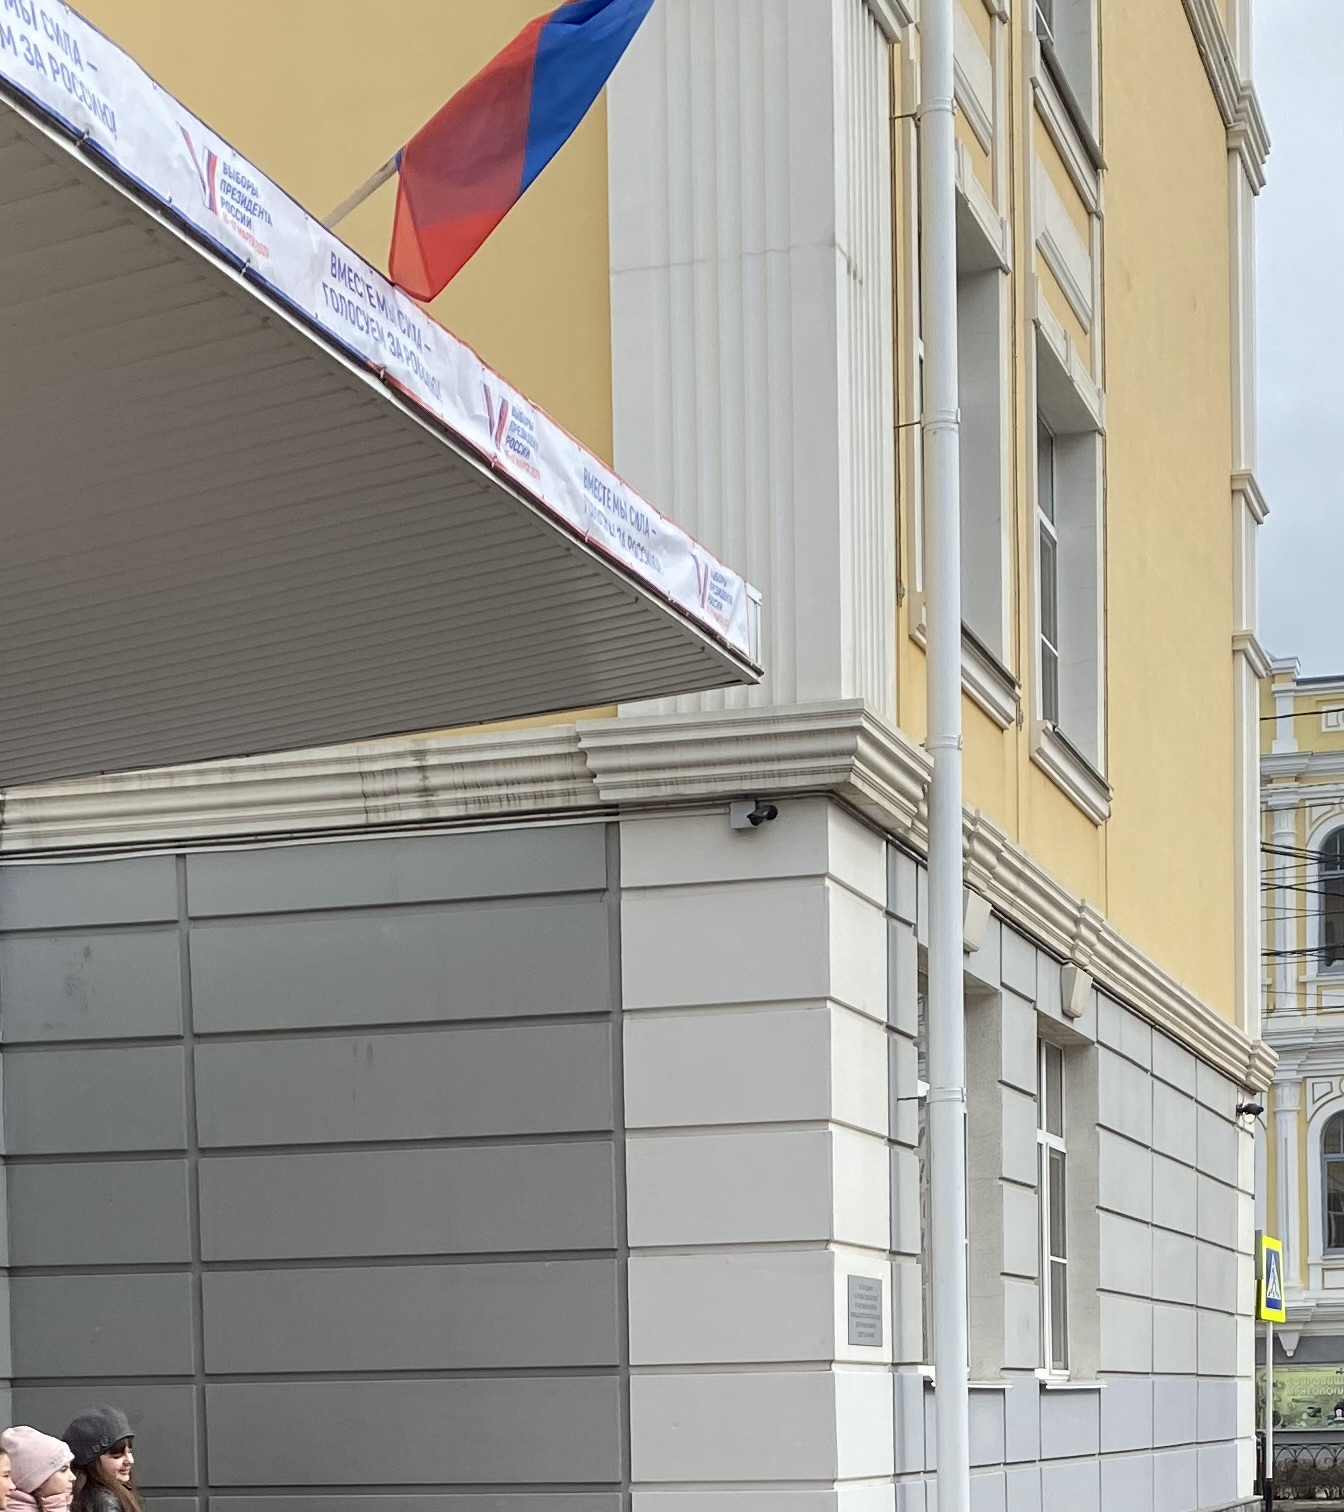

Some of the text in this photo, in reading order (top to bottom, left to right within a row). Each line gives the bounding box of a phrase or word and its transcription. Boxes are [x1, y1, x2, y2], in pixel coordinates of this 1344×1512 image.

[40, 9, 83, 72] СИЛА
[19, 34, 47, 75] ЗА
[48, 52, 117, 140] РОССИЮ!
[220, 178, 273, 226] ПРЕЗИДЕНТА
[220, 196, 252, 230] РОССИИ
[330, 251, 376, 309] ВМЕСТЕ
[397, 309, 423, 353] СИЛА
[387, 331, 404, 363] ЗА
[612, 493, 628, 522] МЫ
